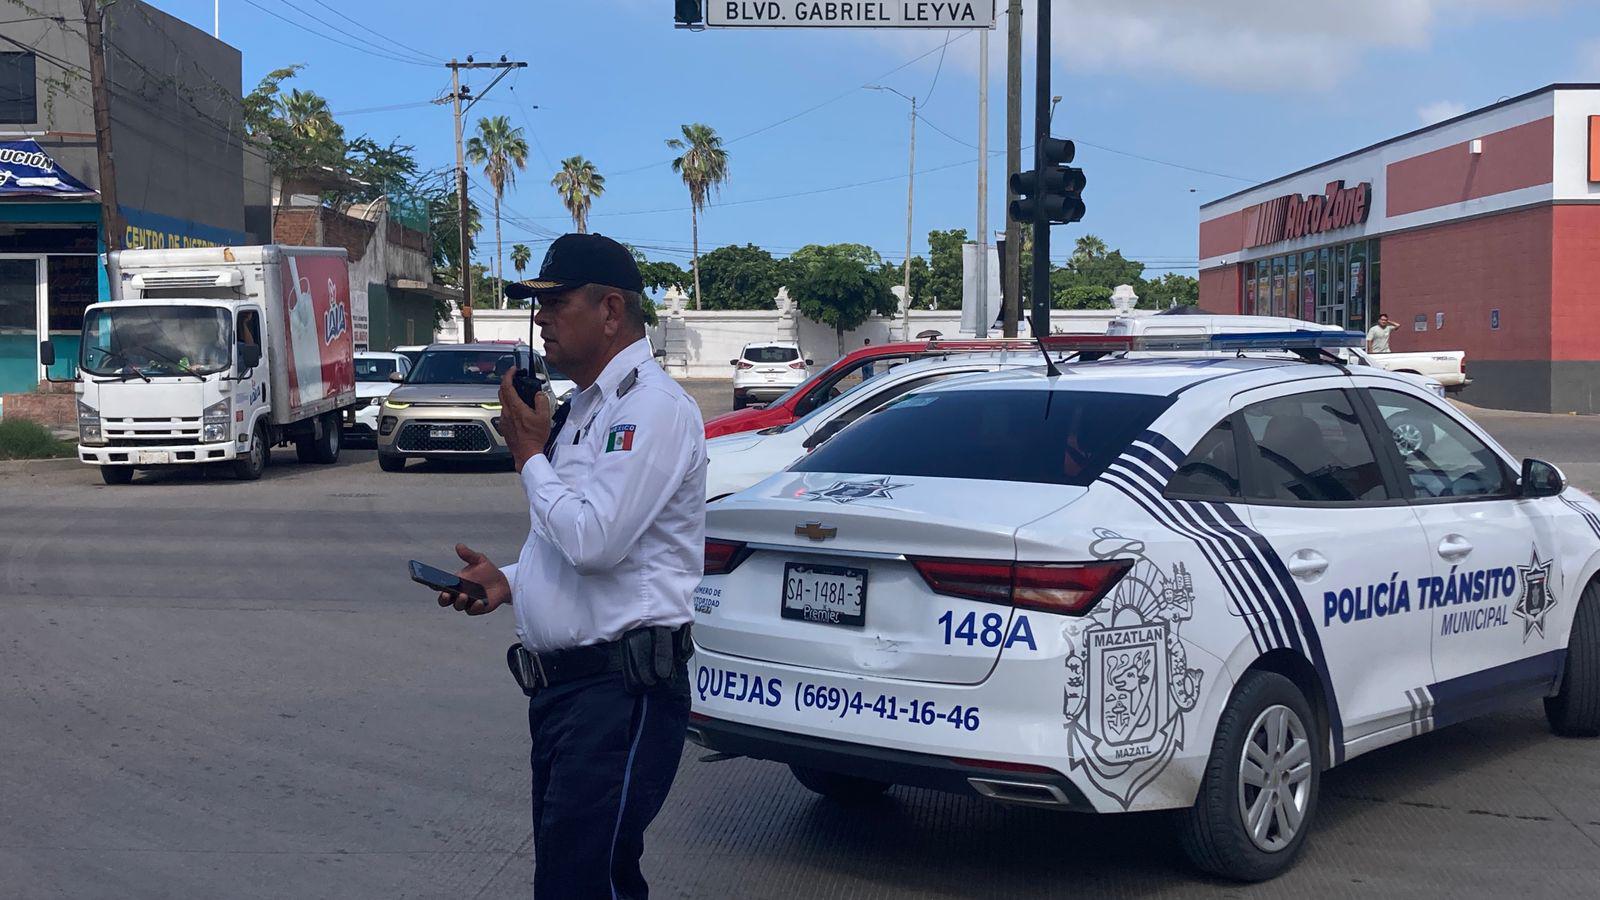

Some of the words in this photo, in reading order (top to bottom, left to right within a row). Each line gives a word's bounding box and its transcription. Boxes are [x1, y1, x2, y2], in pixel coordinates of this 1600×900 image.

[726, 2, 786, 20] BLVD.
[795, 2, 890, 21] GABRIEL
[904, 2, 975, 21] LEYVA
[1283, 180, 1371, 241] AutoZone
[126, 226, 164, 250] CENTRO
[787, 578, 863, 606] SA-148A-3
[1324, 572, 1411, 627] POLICÍA
[1417, 565, 1516, 610] TRÁNSITO
[803, 604, 840, 623] Premier
[1441, 605, 1509, 636] MUNICIPAL
[938, 610, 1038, 650] 148A
[1094, 628, 1163, 647] MAZATLAN
[697, 666, 782, 707] QUEJAS
[795, 682, 980, 731] (669)4-41-16-46
[1115, 745, 1152, 759] MAZATL
